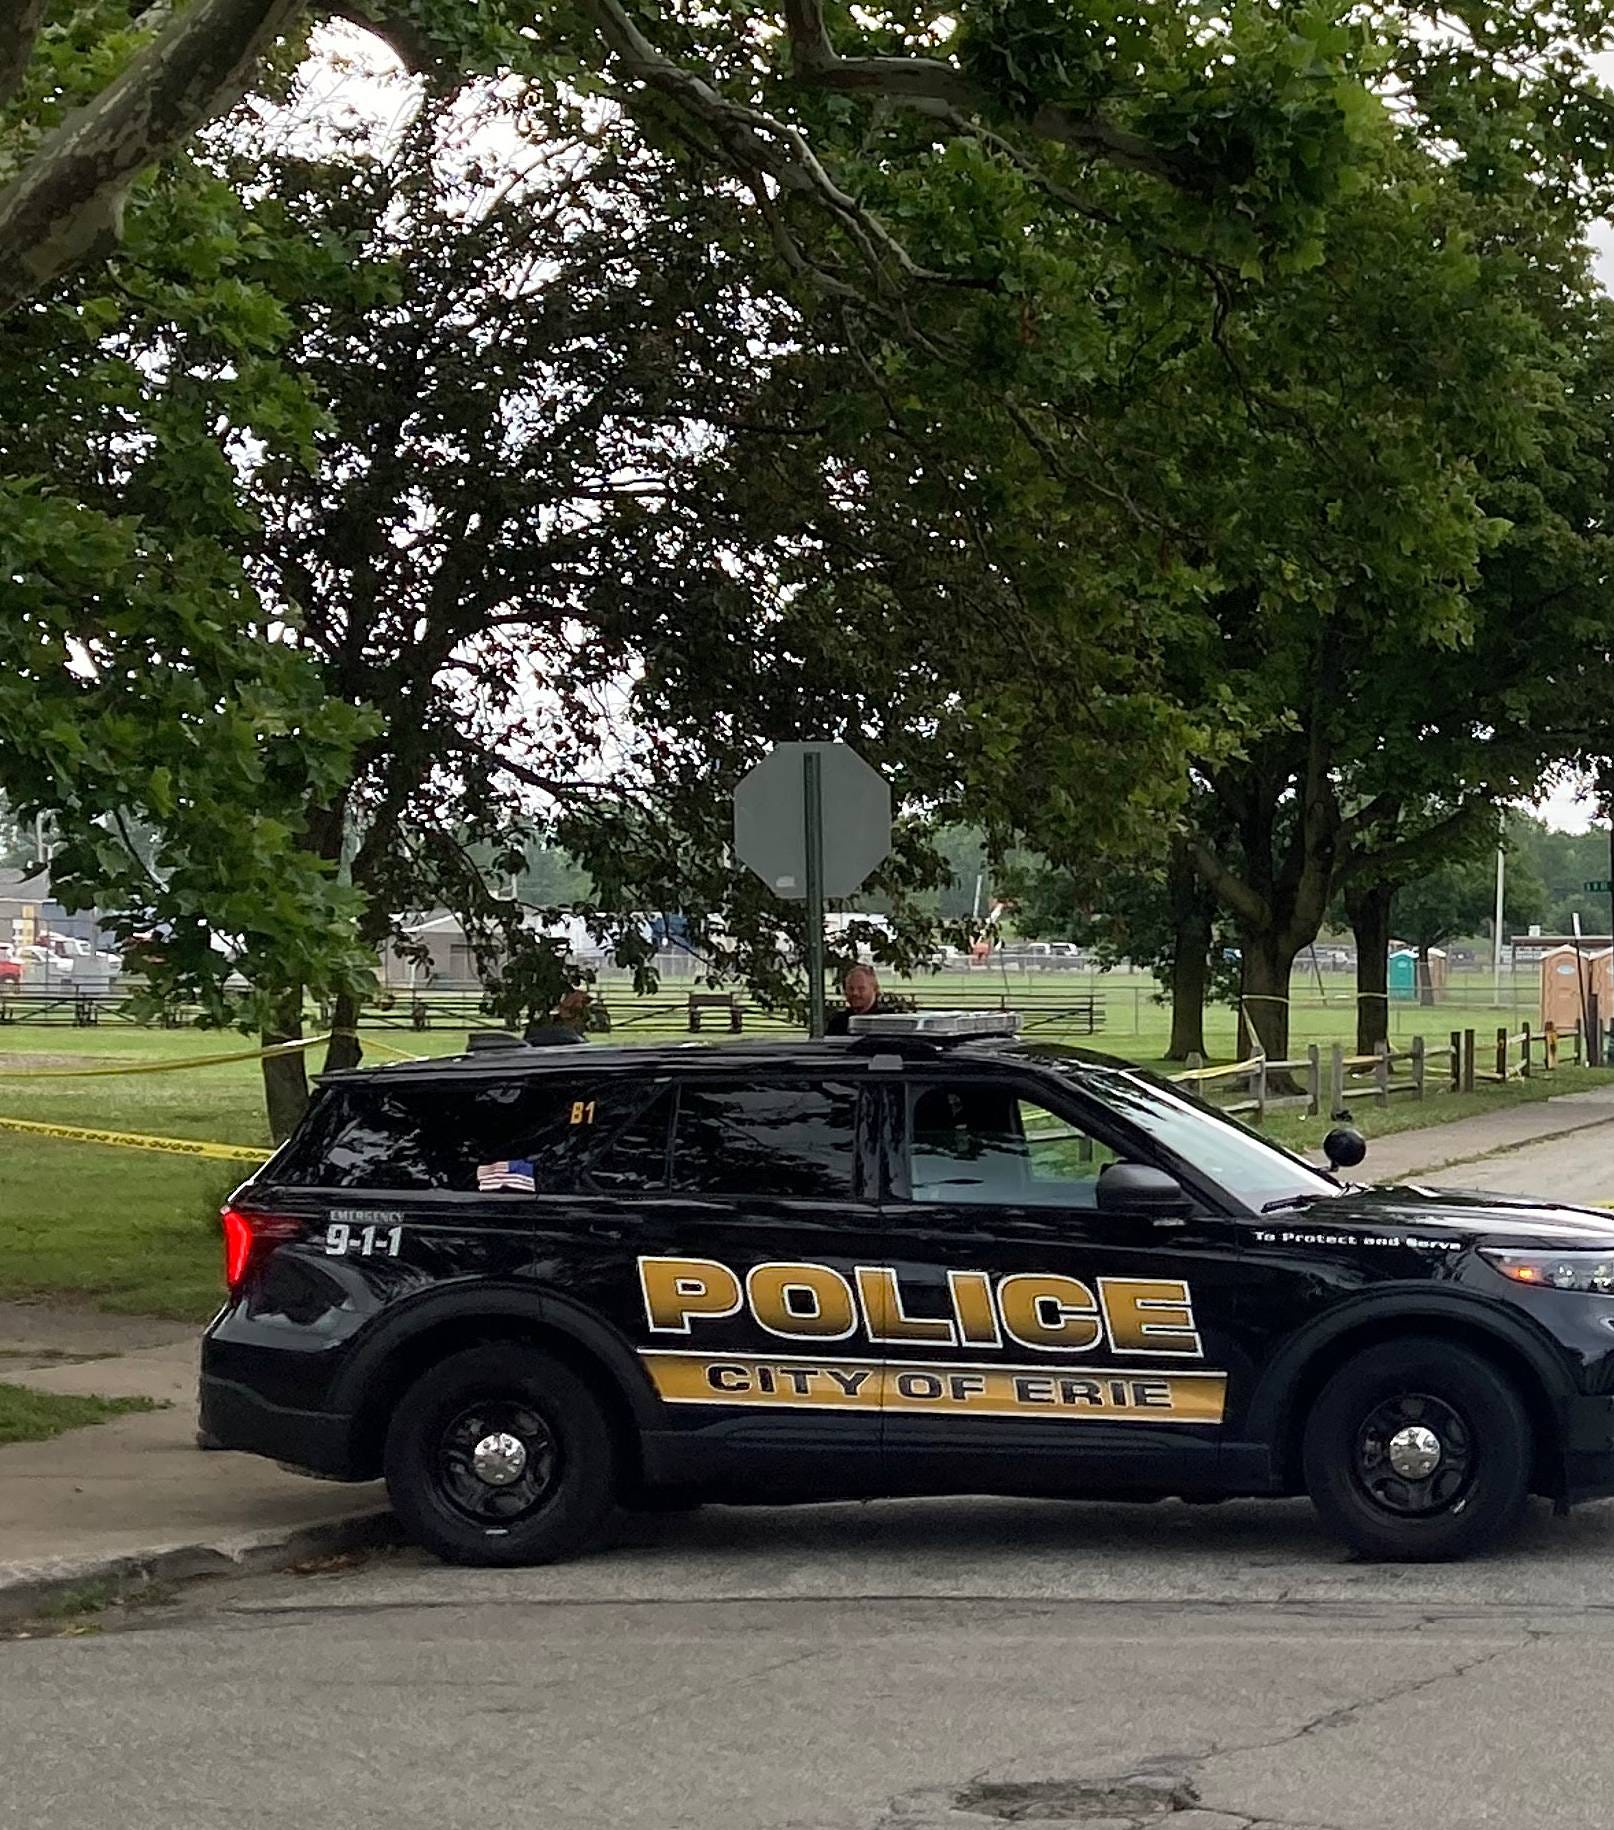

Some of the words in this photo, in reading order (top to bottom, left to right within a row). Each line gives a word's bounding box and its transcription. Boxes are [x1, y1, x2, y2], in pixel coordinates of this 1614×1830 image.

[570, 1101, 596, 1124] B1
[329, 1210, 404, 1223] EMERGENCY
[325, 1224, 402, 1257] 9-1-1
[1253, 1231, 1276, 1242] To
[1281, 1231, 1358, 1246] Protect
[1363, 1236, 1400, 1247] and
[1405, 1237, 1462, 1250] Serve
[637, 1255, 1204, 1358] POLICE
[705, 1363, 871, 1399] CITY
[896, 1372, 988, 1402] OF
[1013, 1375, 1173, 1409] ERIE
